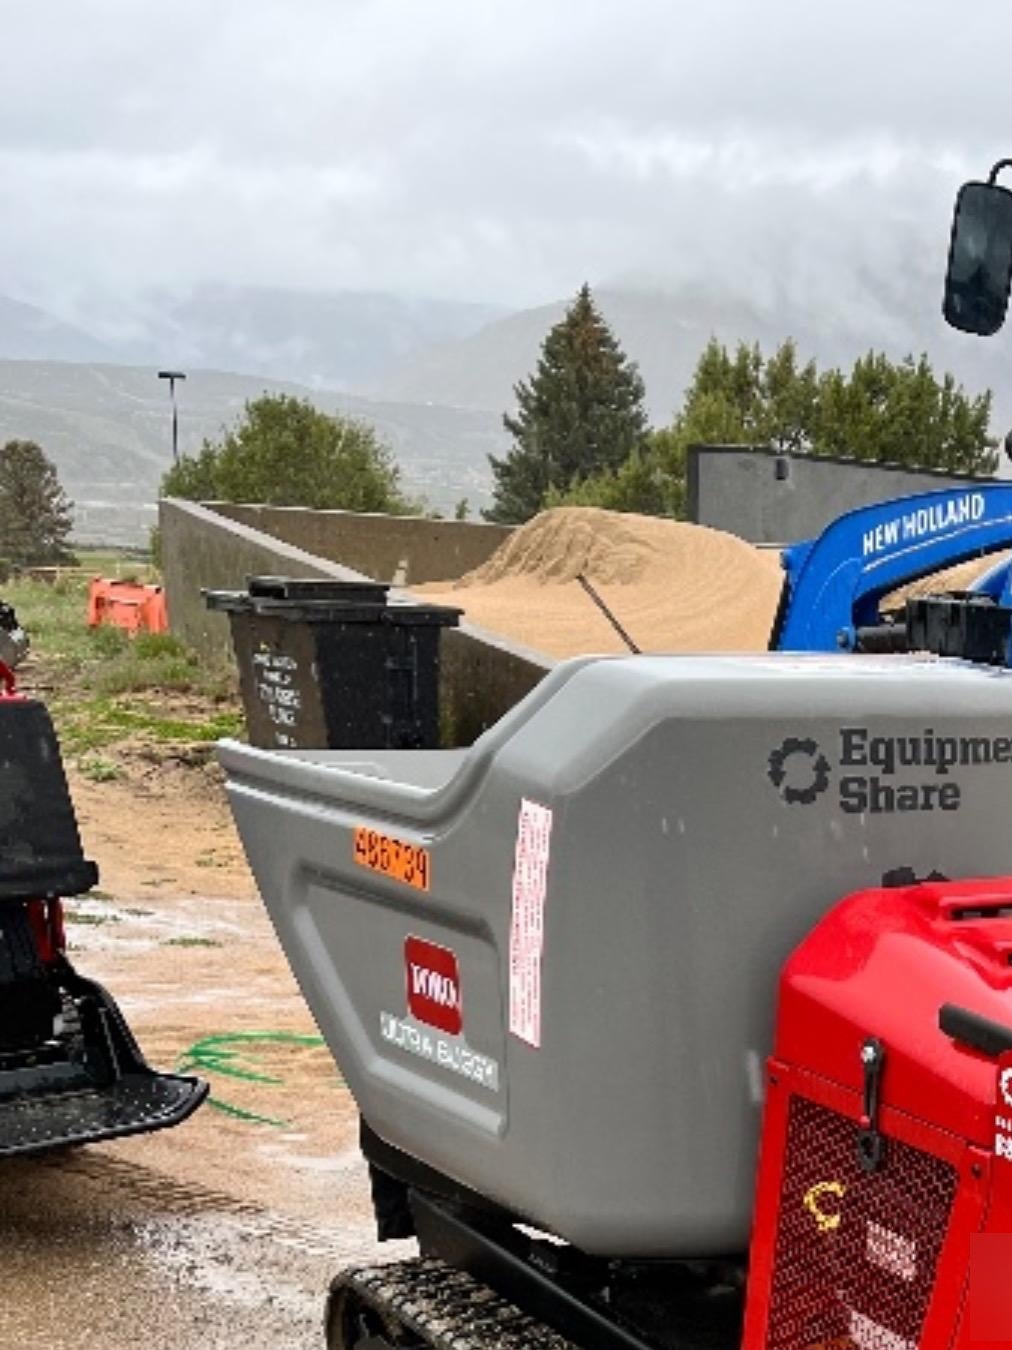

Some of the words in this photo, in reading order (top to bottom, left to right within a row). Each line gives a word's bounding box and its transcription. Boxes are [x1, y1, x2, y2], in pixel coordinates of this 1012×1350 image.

[862, 518, 902, 556] NEW
[902, 493, 985, 541] HOLLAND
[838, 776, 961, 814] Share
